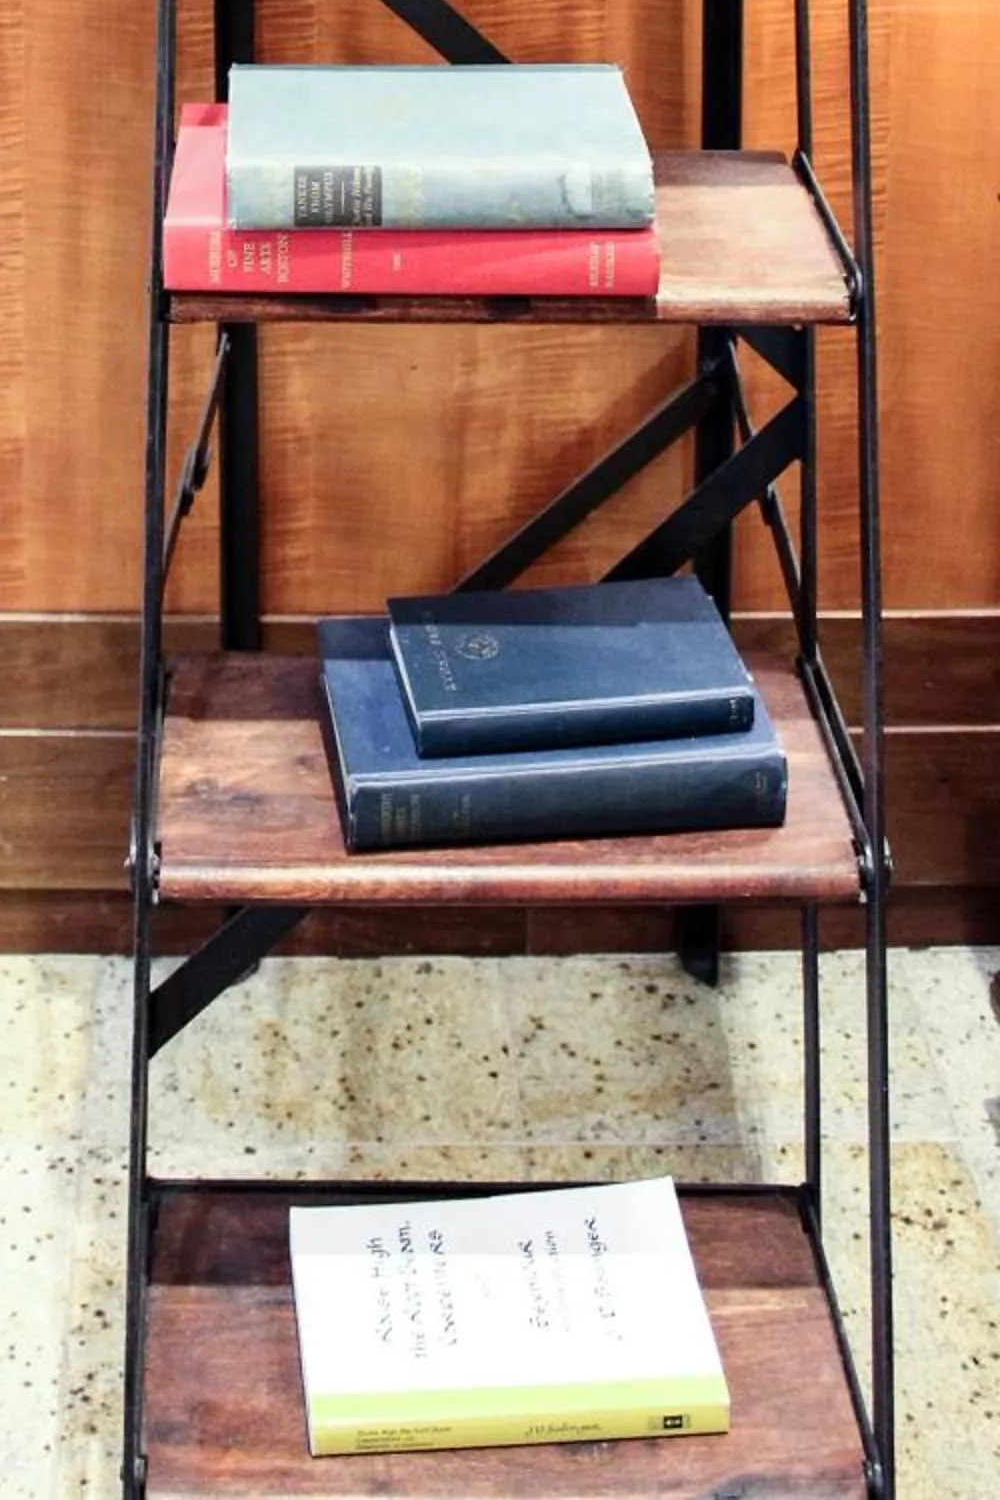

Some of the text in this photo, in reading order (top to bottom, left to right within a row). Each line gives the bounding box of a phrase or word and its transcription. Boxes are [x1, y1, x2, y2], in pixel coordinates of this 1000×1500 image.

[309, 181, 321, 214] FROM
[226, 249, 238, 268] OF
[243, 242, 256, 273] FINE
[259, 242, 272, 275] ARTS
[277, 233, 291, 284] BOSTON
